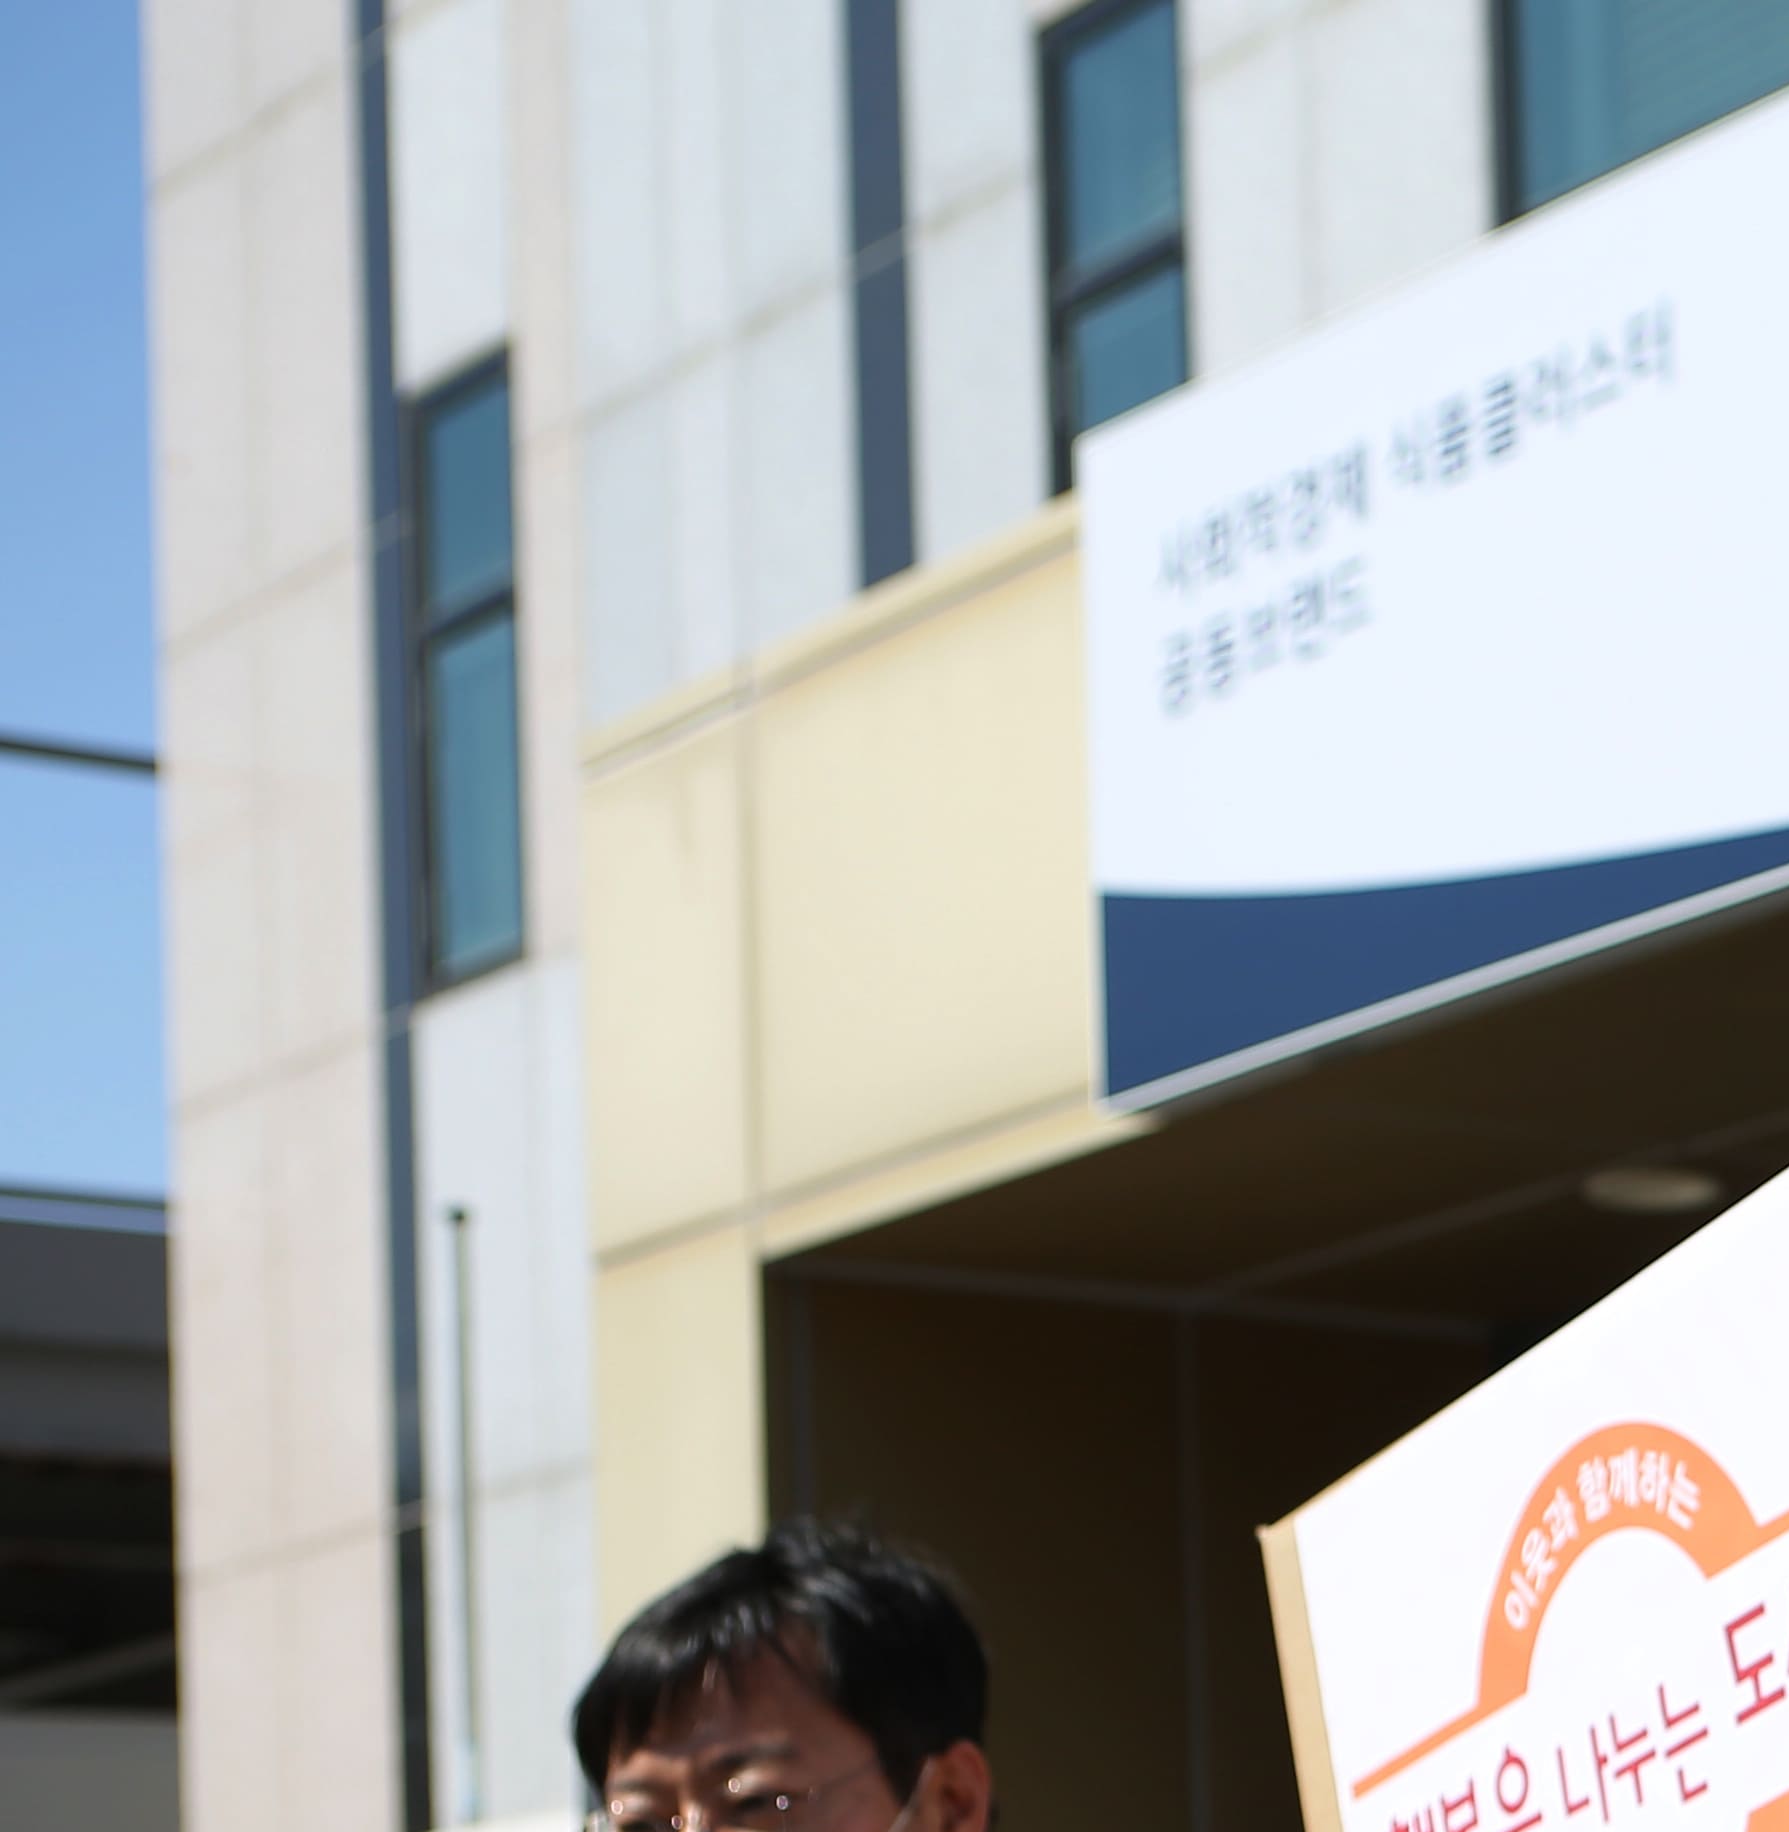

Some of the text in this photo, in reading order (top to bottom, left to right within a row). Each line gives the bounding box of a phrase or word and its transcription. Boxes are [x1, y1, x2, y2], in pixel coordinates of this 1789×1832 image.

[1386, 296, 1677, 490] 식품클러스터
[1503, 1446, 1701, 1631] 이웃과 함께하는
[1556, 1683, 1710, 1823] 나누는
